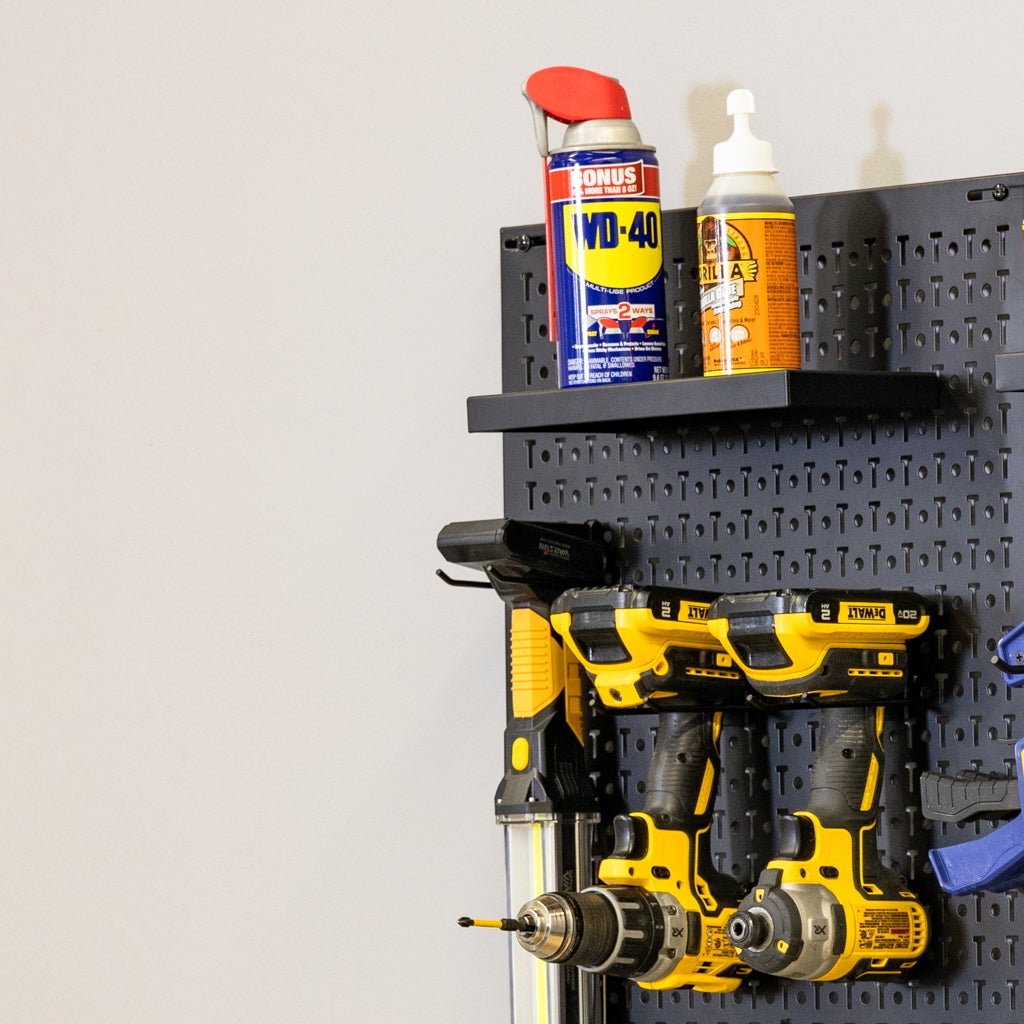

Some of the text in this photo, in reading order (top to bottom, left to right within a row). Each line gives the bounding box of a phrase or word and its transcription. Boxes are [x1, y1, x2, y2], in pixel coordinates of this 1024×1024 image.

[604, 186, 621, 194] THAN
[572, 211, 659, 249] WD-40
[585, 281, 654, 294] MULTI-USE PRODUCT
[590, 308, 618, 316] SPRAYS
[618, 303, 631, 319] 2
[661, 606, 671, 618] 2
[821, 609, 831, 620] 2
[848, 607, 886, 619] DEWALT
